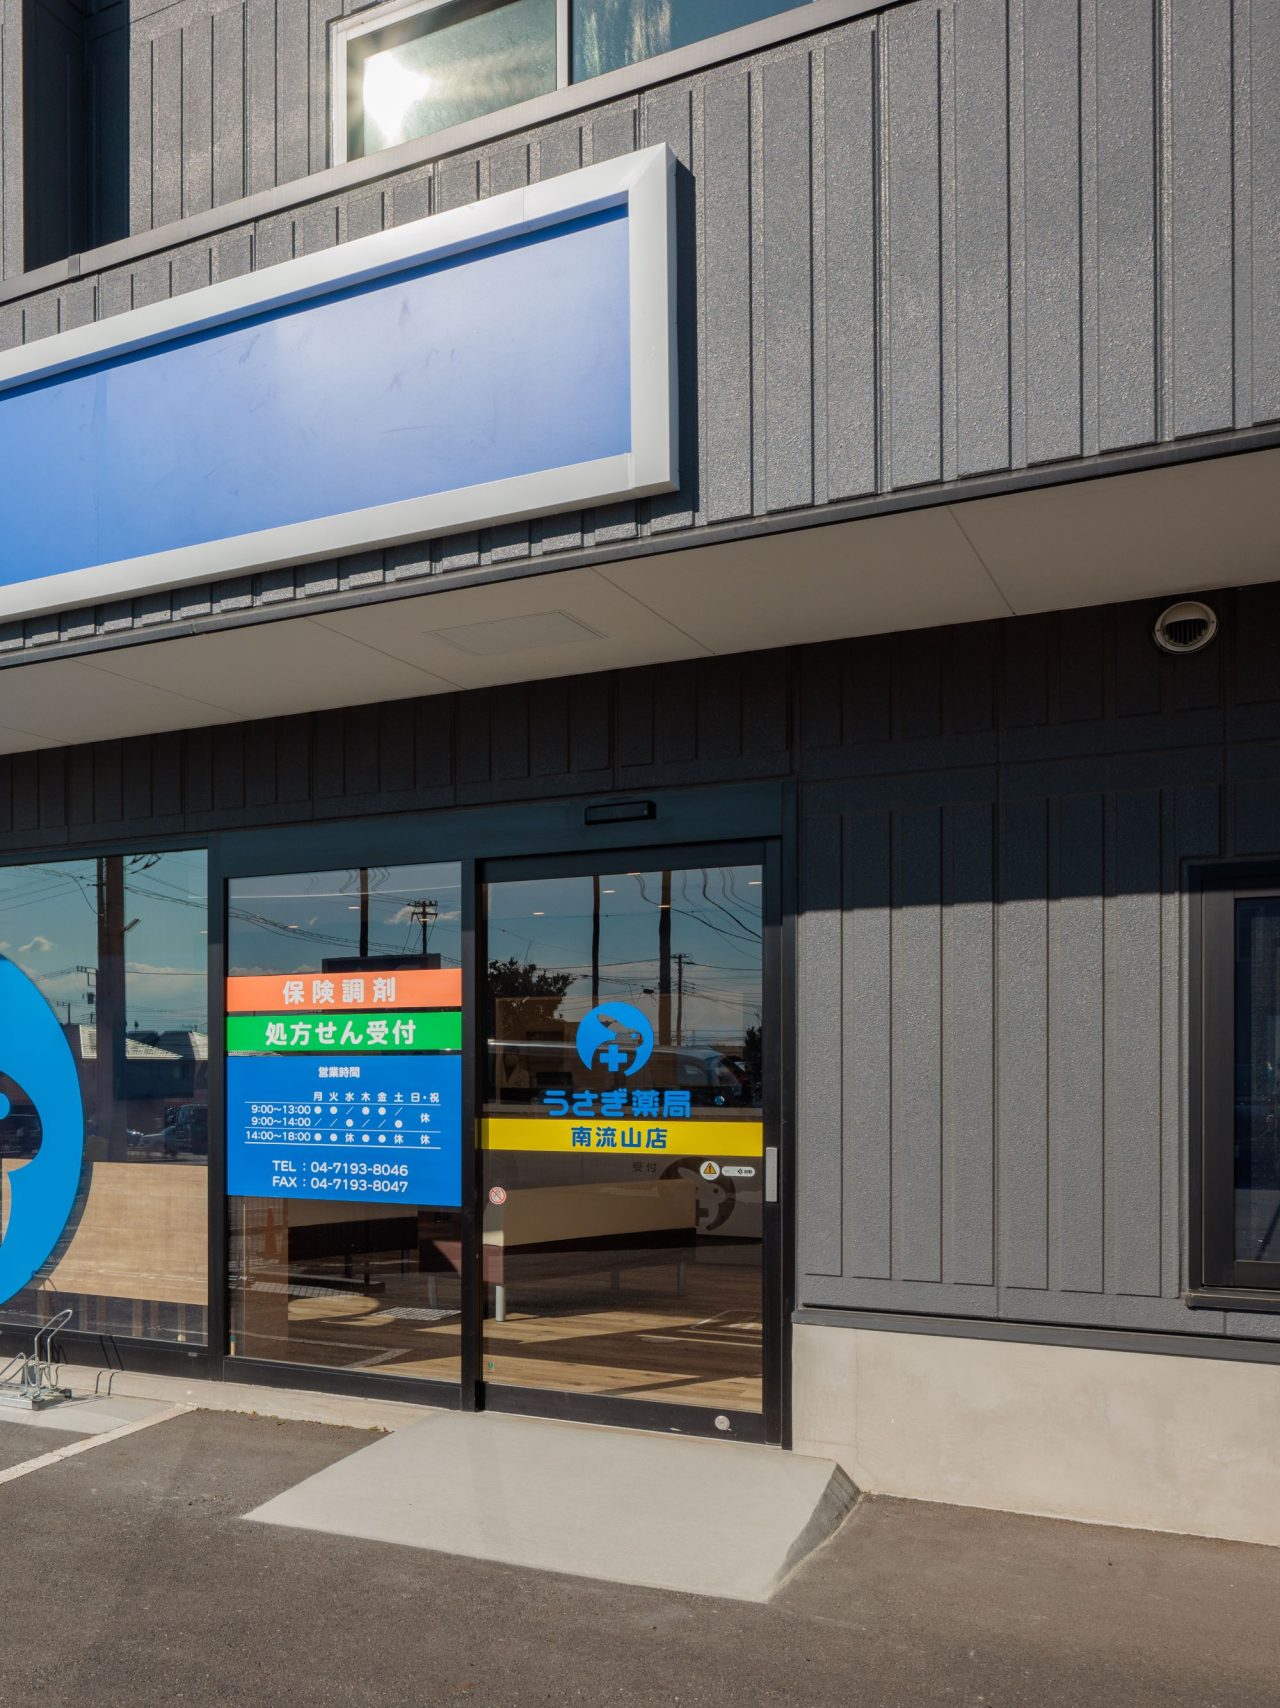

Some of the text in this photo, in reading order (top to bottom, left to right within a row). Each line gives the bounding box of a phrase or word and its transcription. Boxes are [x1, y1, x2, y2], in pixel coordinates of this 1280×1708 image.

[283, 976, 396, 1005] 保険調剤
[265, 1019, 416, 1046] 処方せん受付
[318, 1066, 361, 1079] 営業時間
[543, 1088, 691, 1118] うさぎ薬局
[420, 1112, 431, 1123] 休
[344, 1132, 355, 1143] 休
[393, 1133, 404, 1145] 休
[420, 1134, 431, 1145] 休
[571, 1126, 667, 1149] 南流山店
[272, 1159, 297, 1172] TEL
[310, 1161, 409, 1177] 04-7193-8046
[272, 1175, 297, 1188] FAX
[310, 1177, 409, 1193] 04-7193-8047
